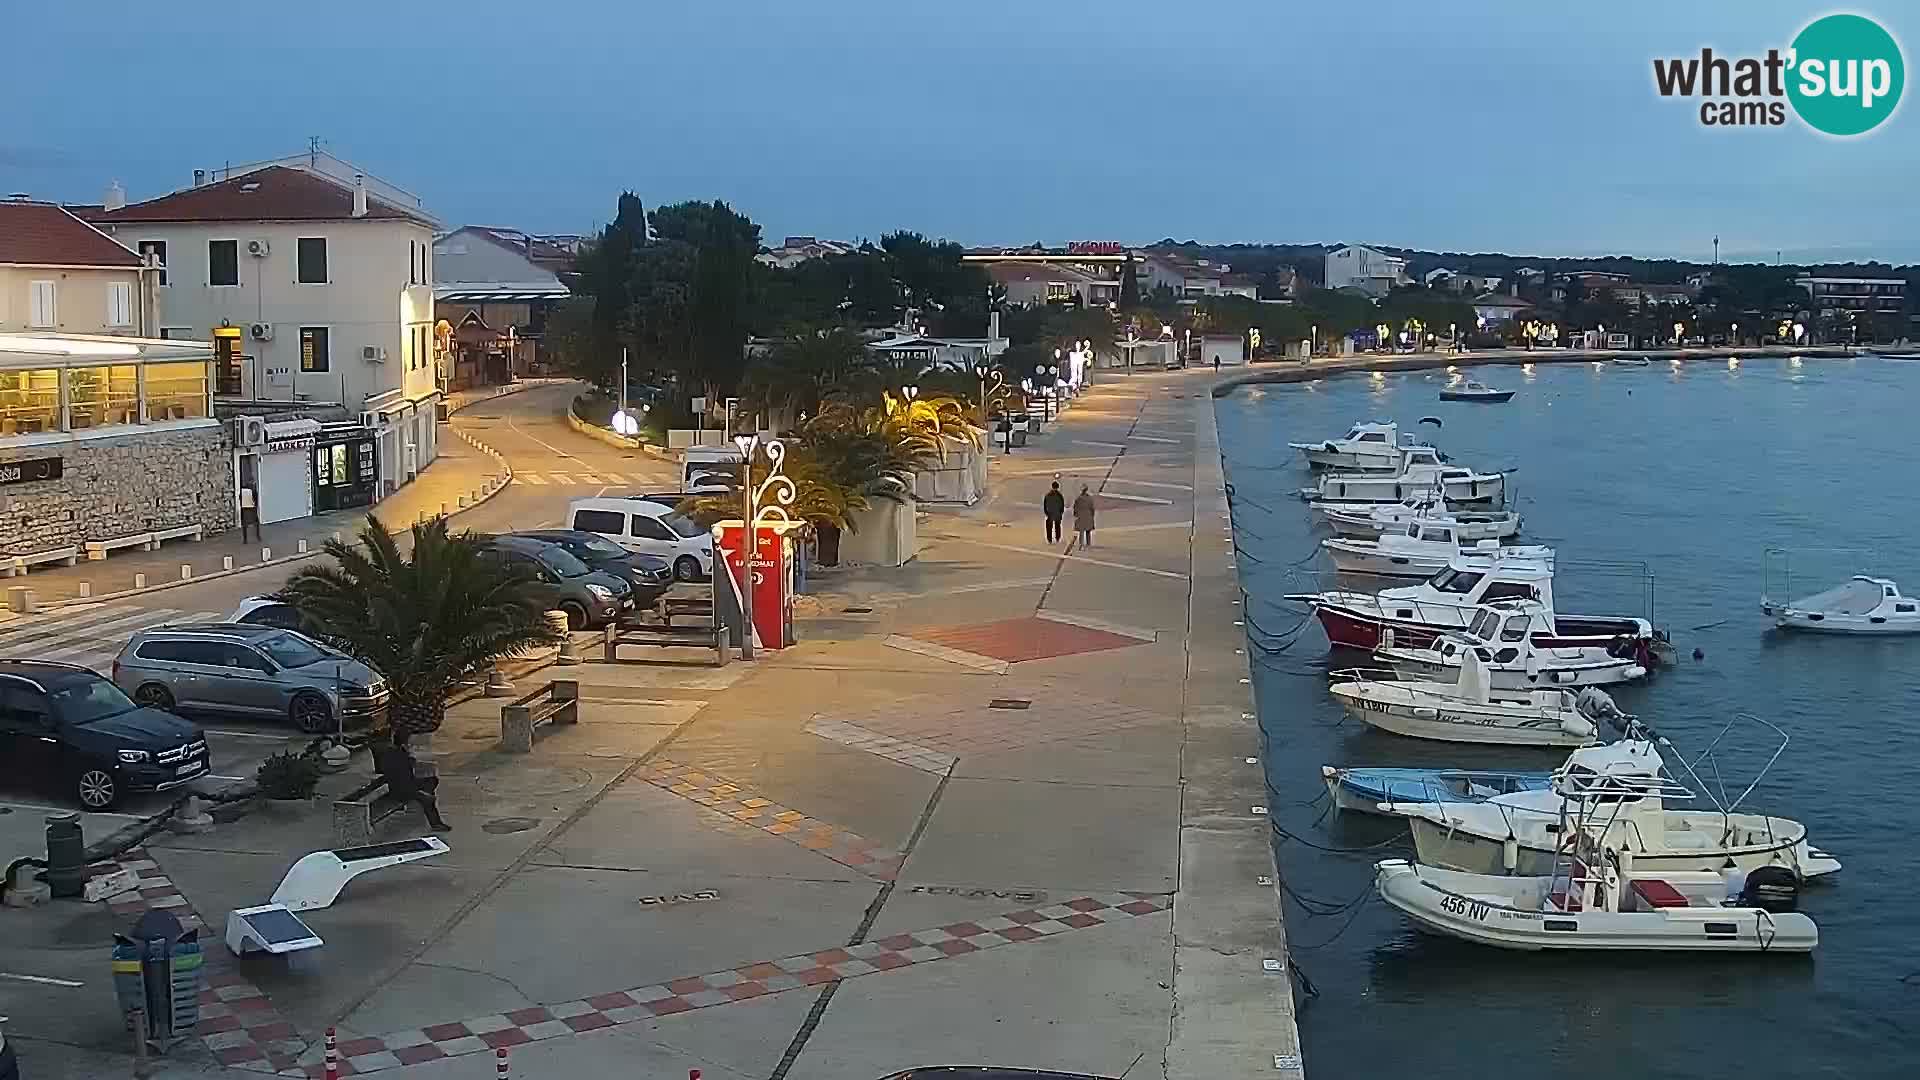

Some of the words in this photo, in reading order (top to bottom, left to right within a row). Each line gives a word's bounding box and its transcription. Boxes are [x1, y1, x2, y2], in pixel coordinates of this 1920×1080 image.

[268, 440, 309, 453] MARKET
[1440, 896, 1466, 915] 456
[1468, 903, 1490, 921] NV
